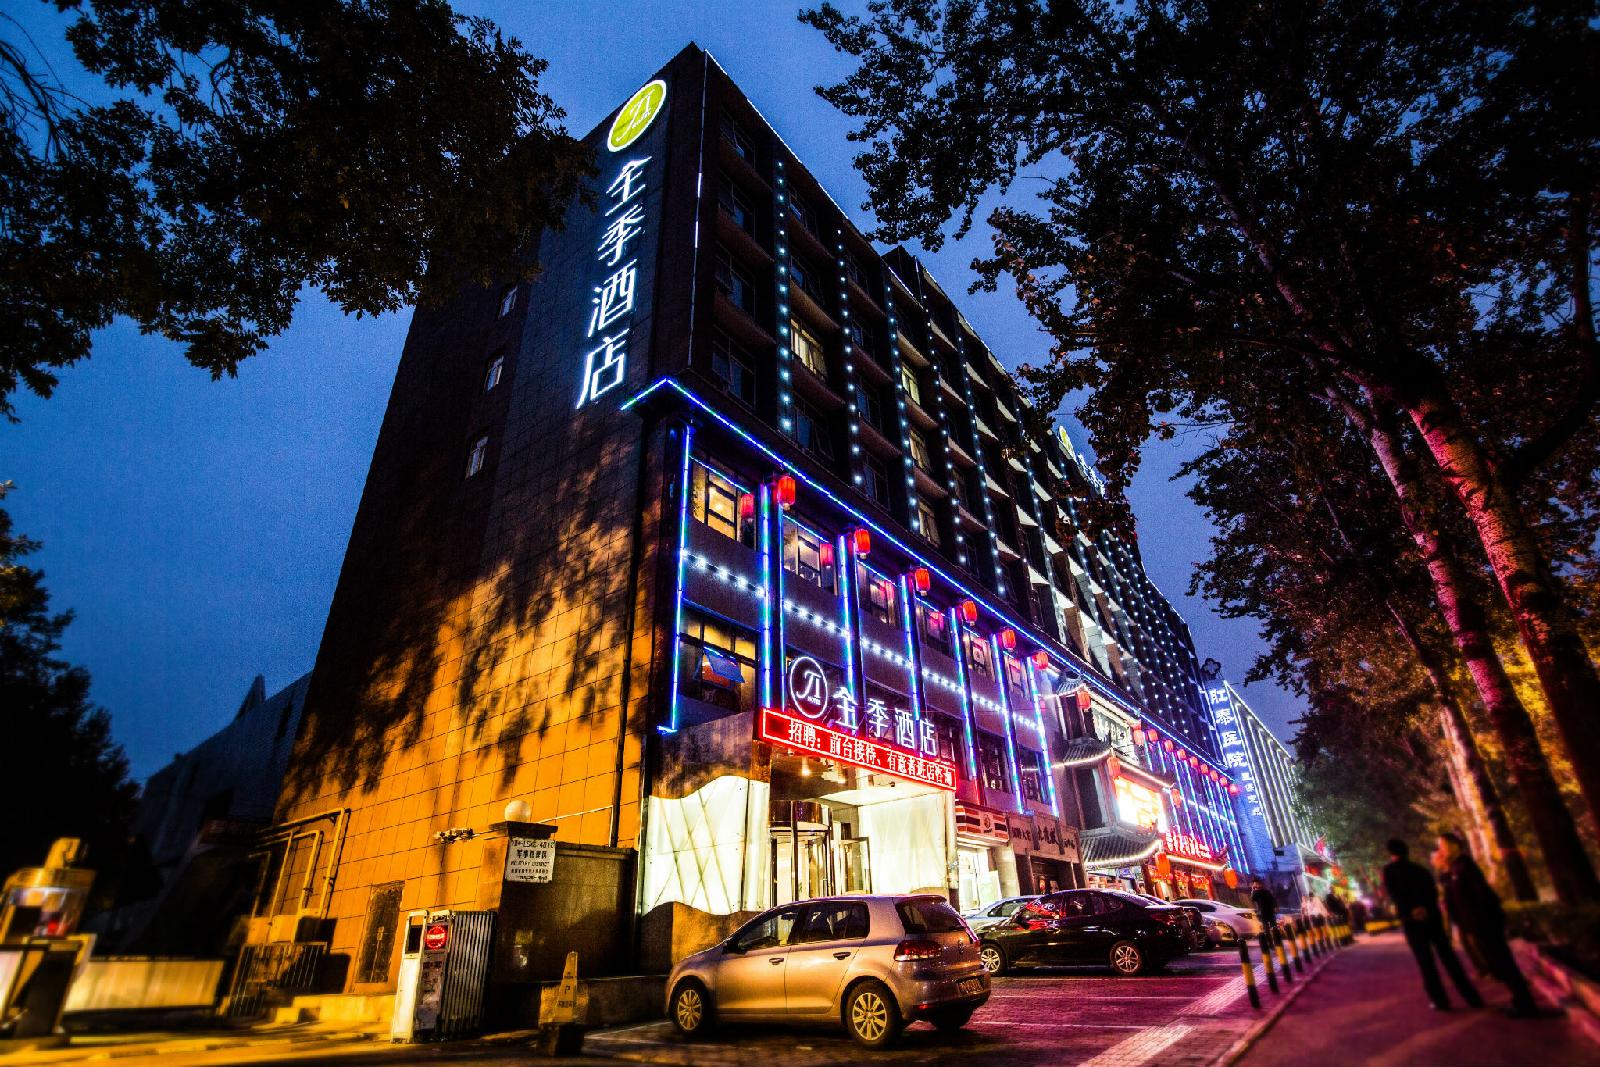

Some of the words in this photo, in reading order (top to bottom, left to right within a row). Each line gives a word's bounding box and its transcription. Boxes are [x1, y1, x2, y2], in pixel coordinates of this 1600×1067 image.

[576, 155, 653, 410] 全季酒店
[832, 686, 937, 757] 全季酒店
